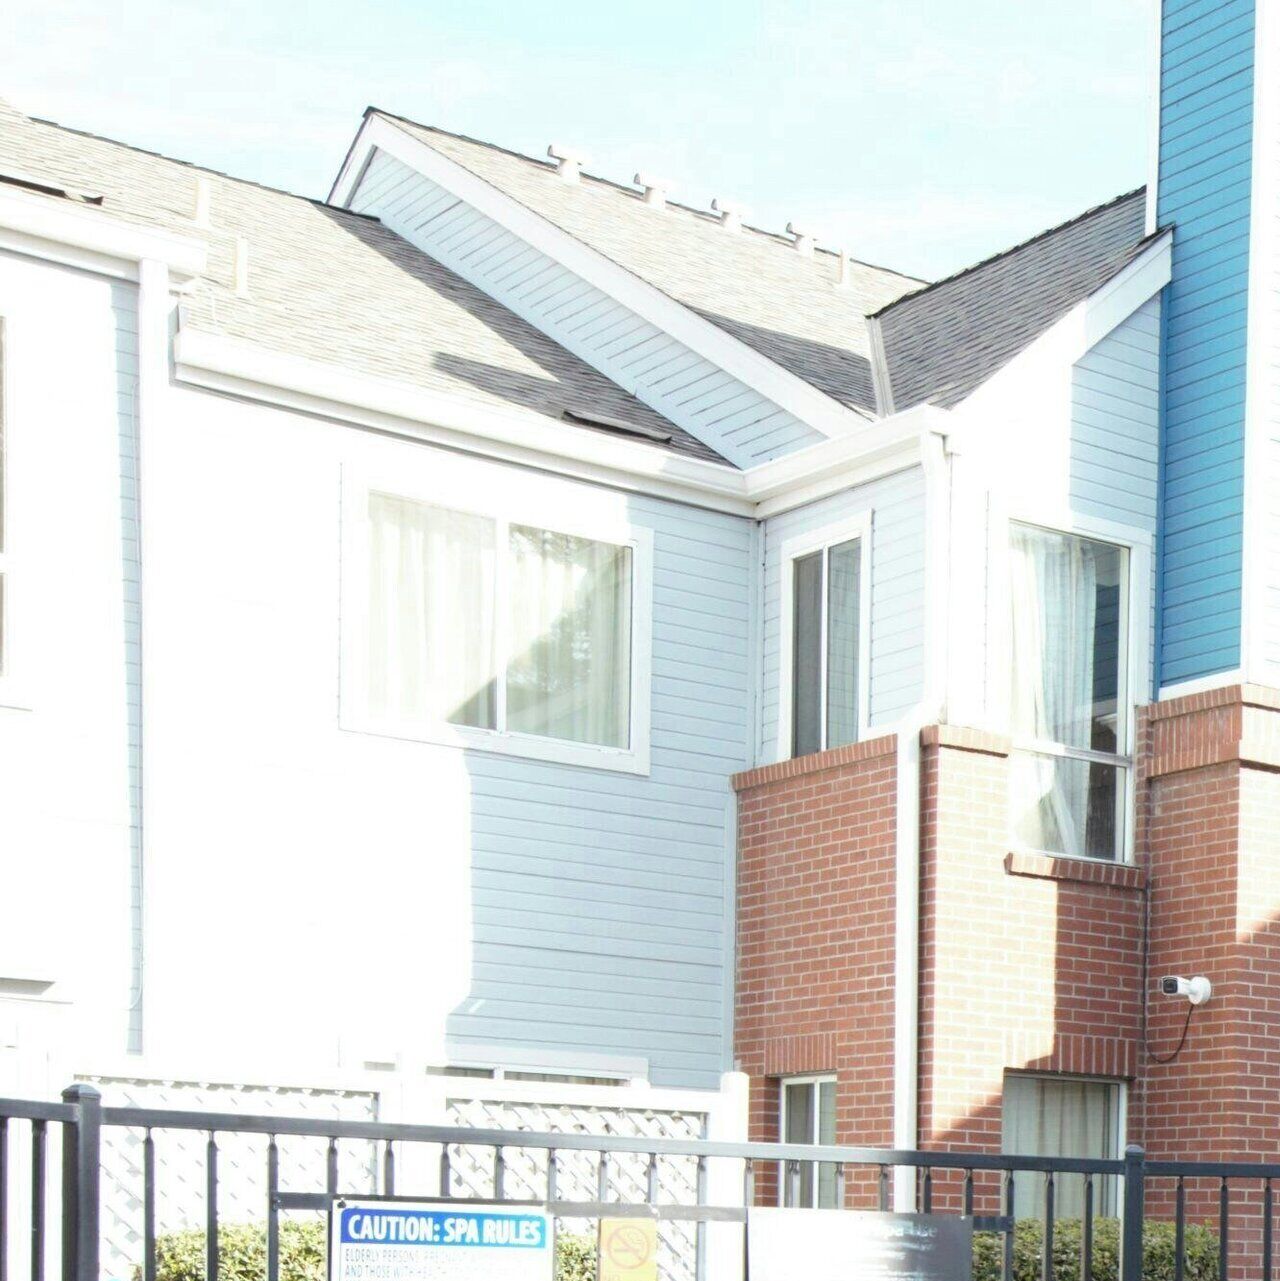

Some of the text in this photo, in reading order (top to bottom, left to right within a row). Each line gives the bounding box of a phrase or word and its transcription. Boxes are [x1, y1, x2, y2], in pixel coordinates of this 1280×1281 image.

[348, 1214, 542, 1245] CAUTION: SPA RULES
[344, 1249, 380, 1262] ELDERLY
[344, 1265, 362, 1278] AND
[363, 1265, 391, 1278] THOSE
